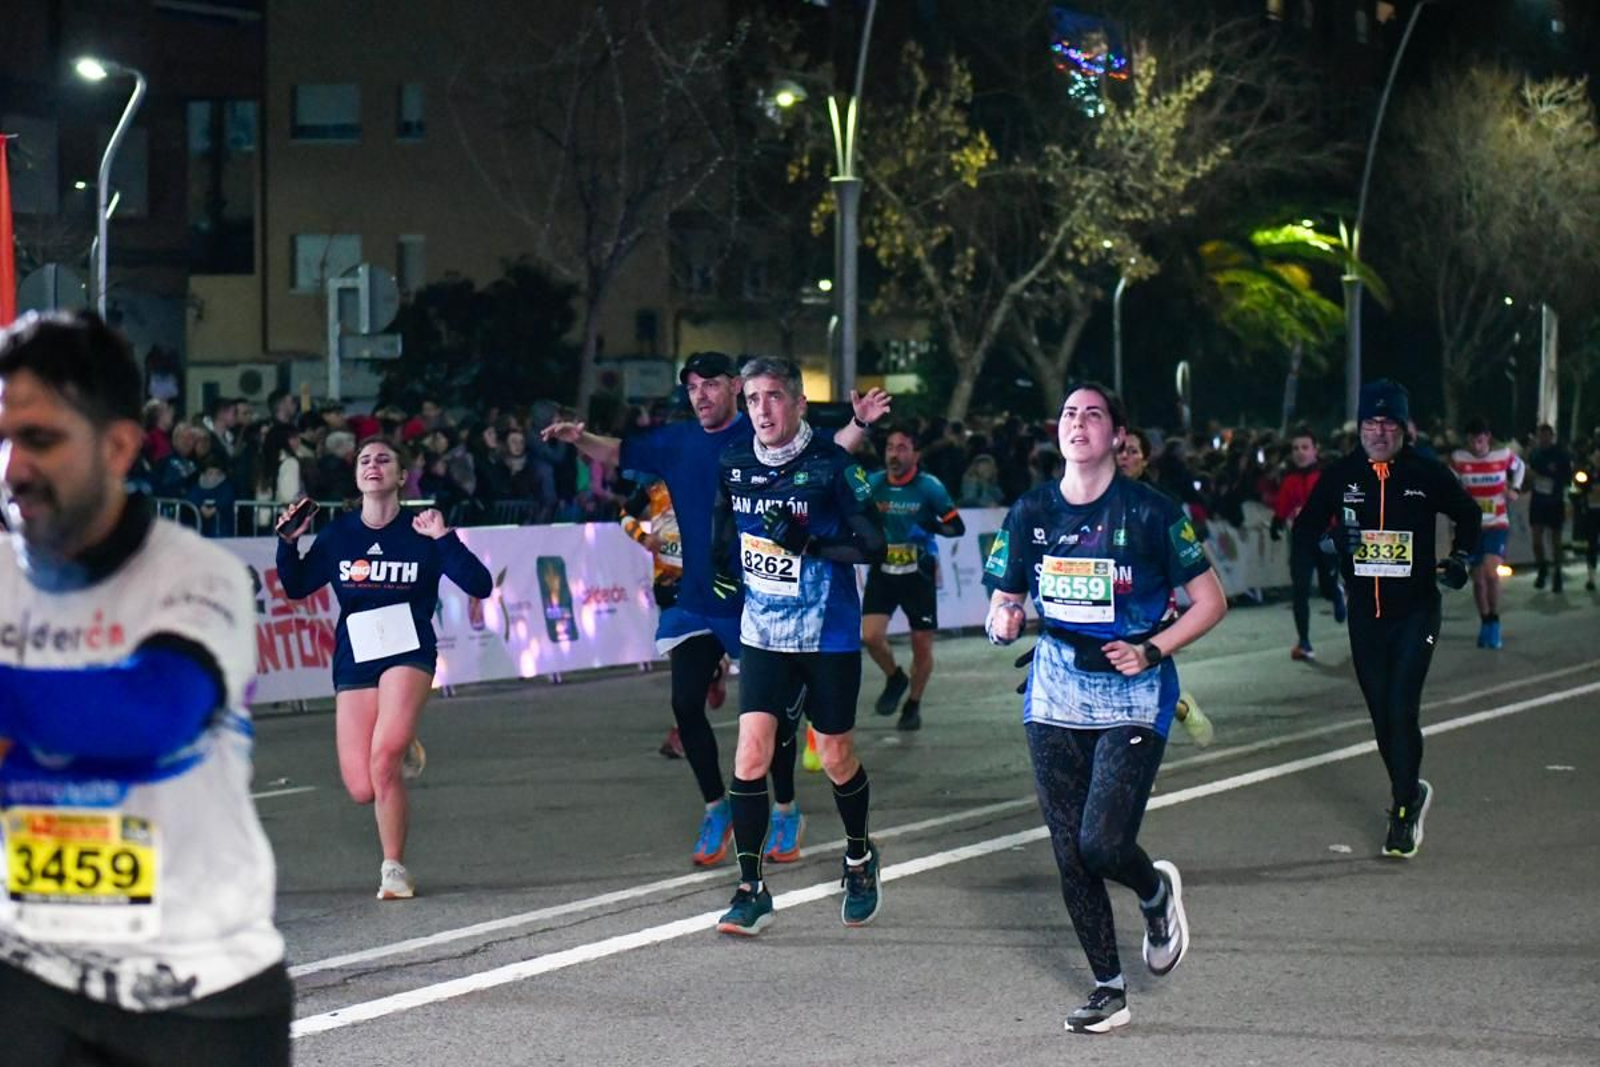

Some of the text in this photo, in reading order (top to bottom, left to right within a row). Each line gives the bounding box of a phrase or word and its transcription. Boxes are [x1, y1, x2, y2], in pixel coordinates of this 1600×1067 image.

[744, 550, 793, 576] 8262
[1357, 543, 1407, 559] 3332
[339, 560, 419, 583] SOUTH
[1042, 575, 1105, 599] 2659
[16, 844, 140, 889] 3459
